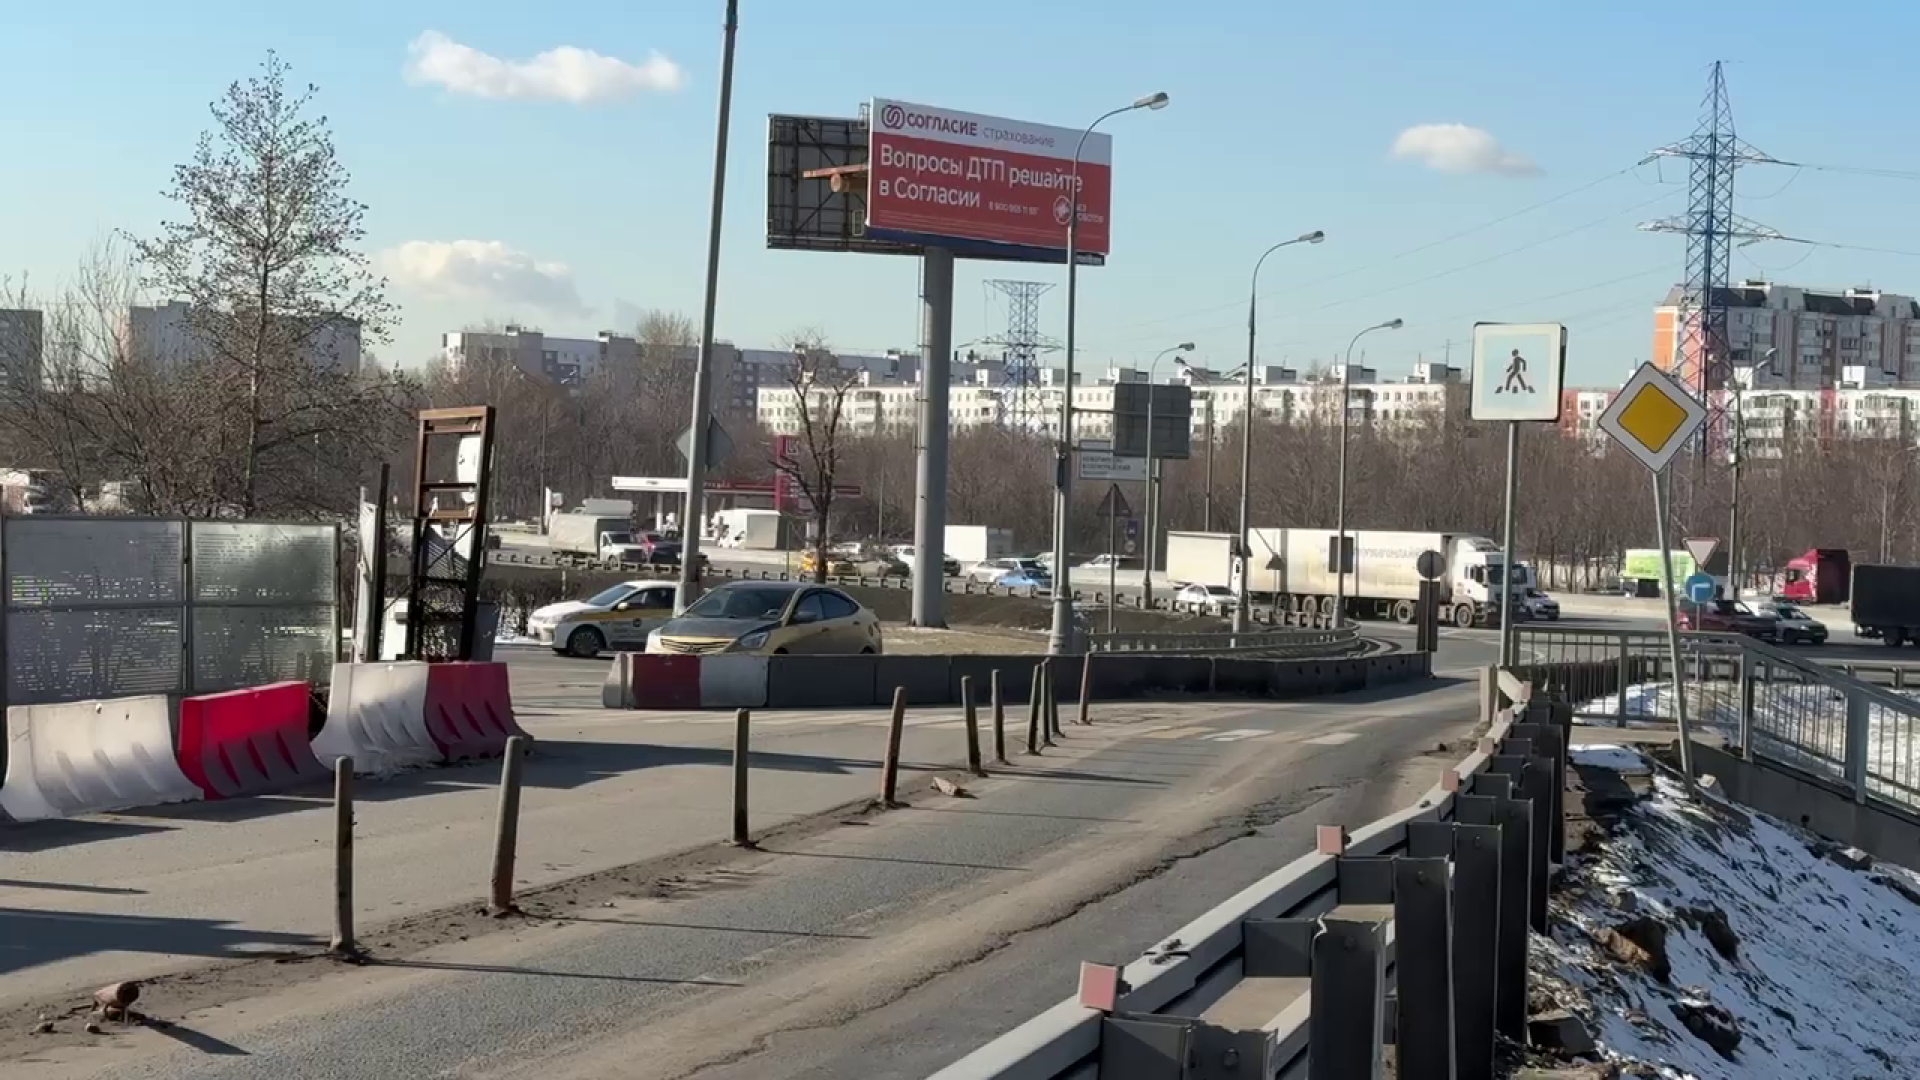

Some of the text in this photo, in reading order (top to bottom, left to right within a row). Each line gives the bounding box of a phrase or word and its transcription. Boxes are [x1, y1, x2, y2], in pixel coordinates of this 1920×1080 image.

[907, 112, 1055, 148] СОГЛАСИЕ страхование
[881, 143, 1083, 193] Вопросы ДТП решайте
[879, 176, 980, 208] в Согласии
